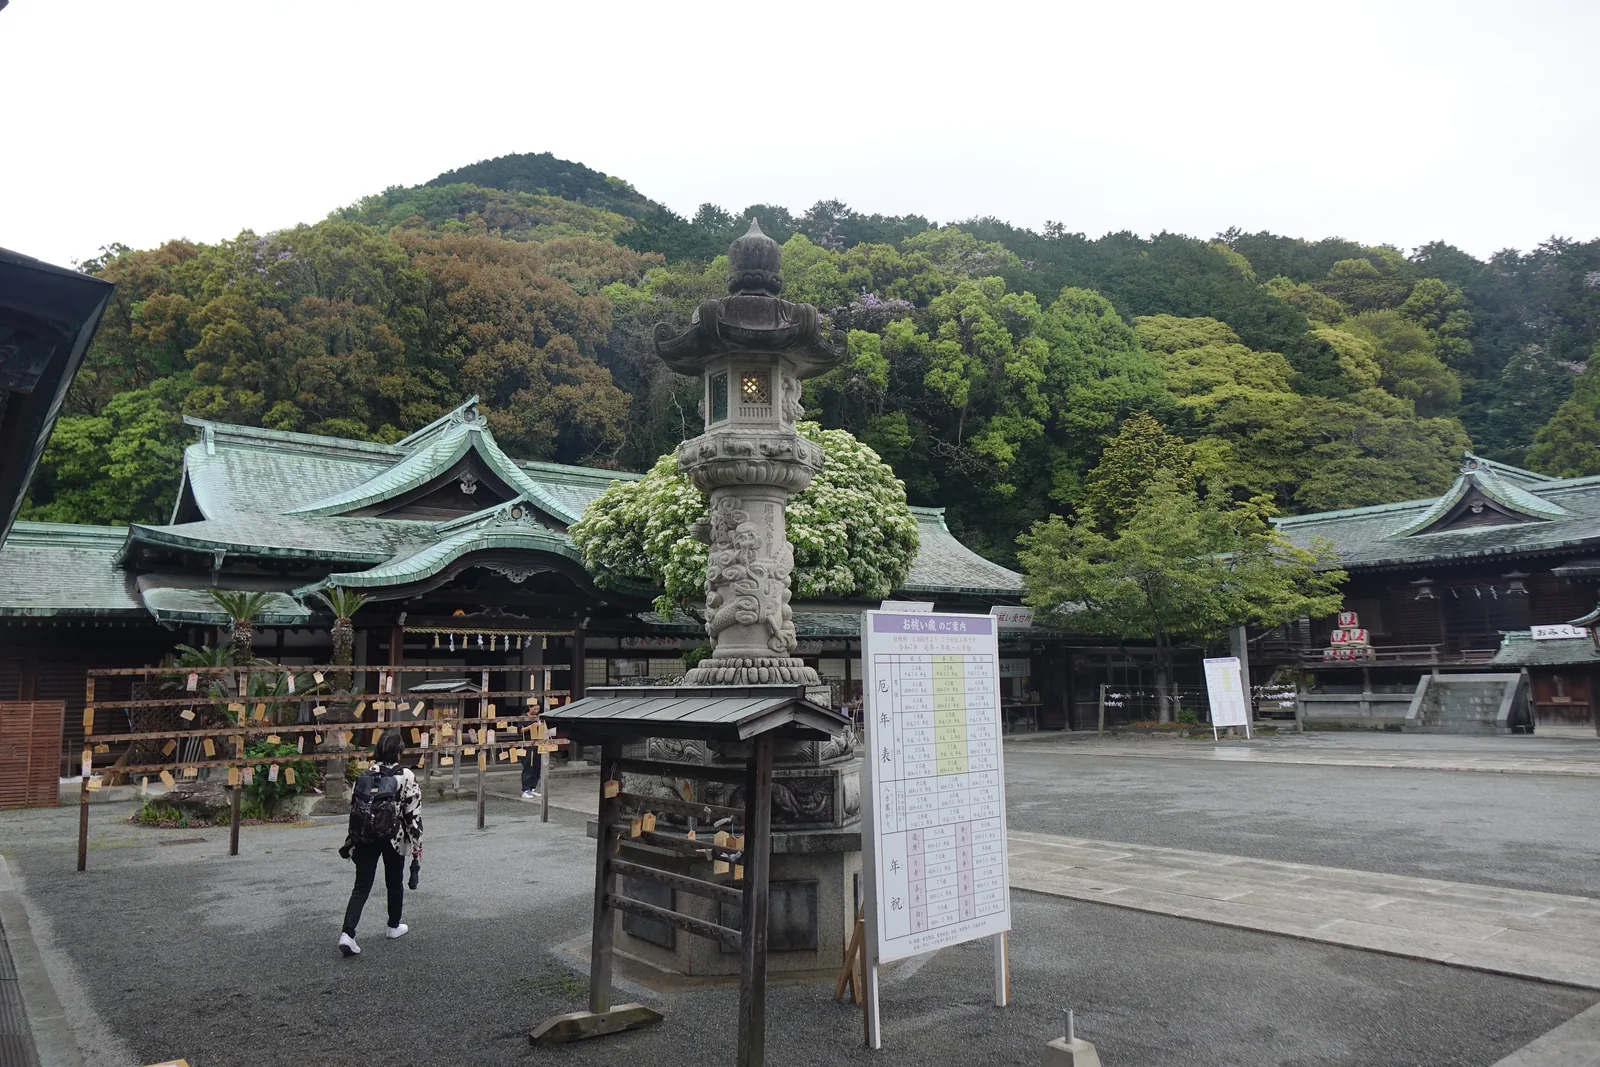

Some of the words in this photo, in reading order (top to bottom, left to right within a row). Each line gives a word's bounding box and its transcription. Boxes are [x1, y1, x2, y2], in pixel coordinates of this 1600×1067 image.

[994, 613, 1032, 623] 祓い受付所
